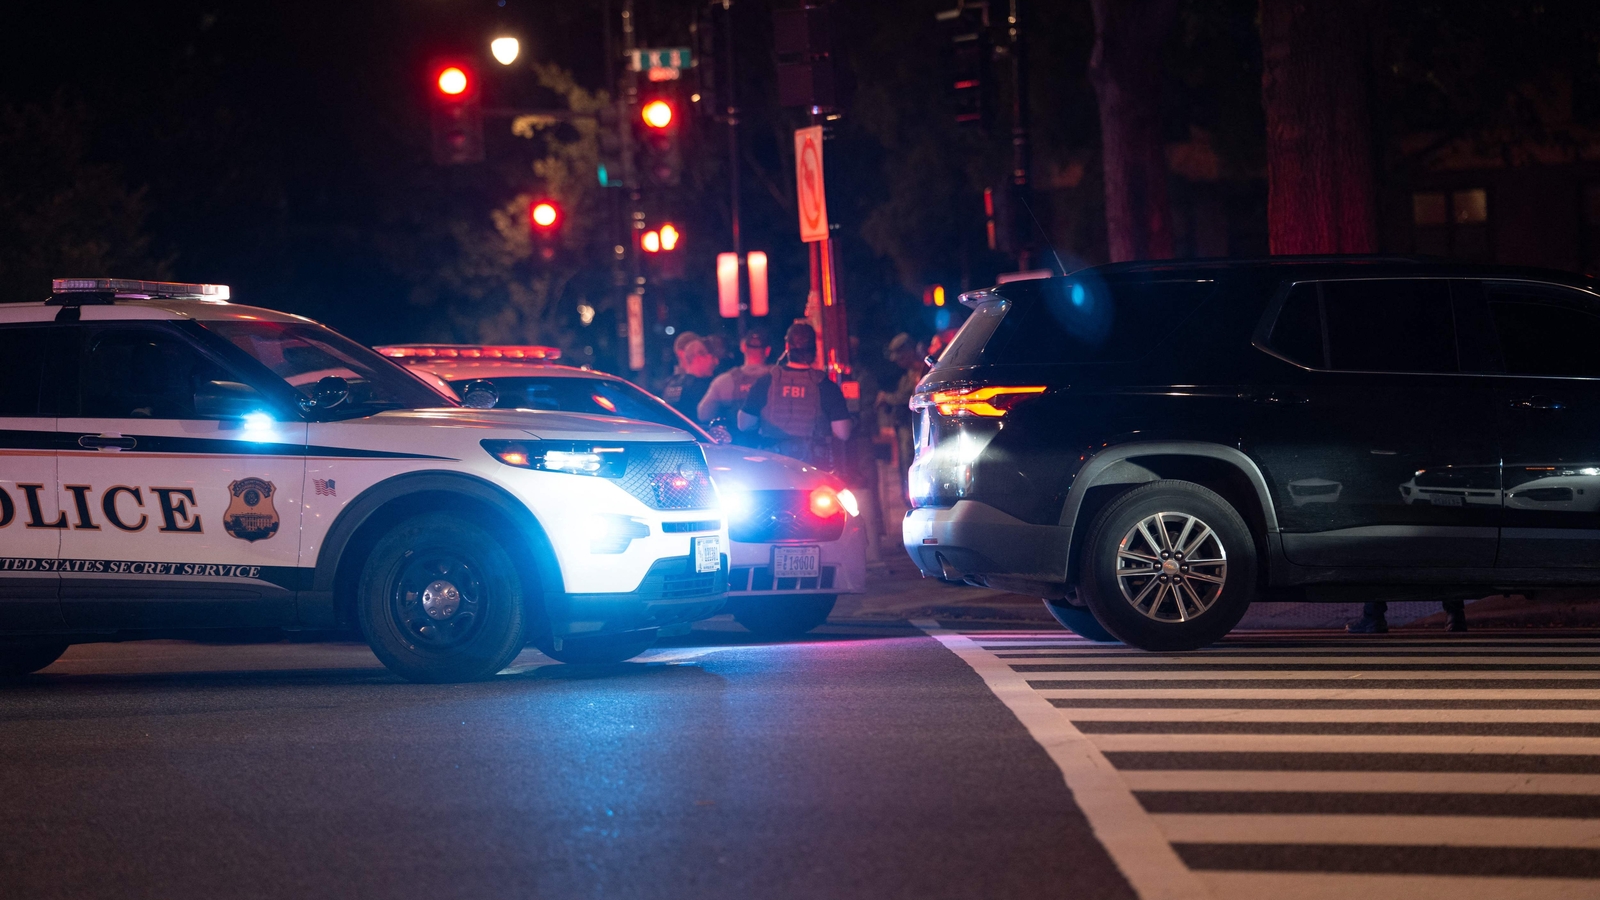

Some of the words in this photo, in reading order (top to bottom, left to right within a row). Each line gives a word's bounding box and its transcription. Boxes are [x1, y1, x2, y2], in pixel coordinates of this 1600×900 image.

[782, 385, 805, 398] FBI
[0, 558, 37, 570] TED
[40, 559, 104, 572] STATES
[108, 562, 180, 575] SECRET
[182, 563, 261, 578] SERVICE
